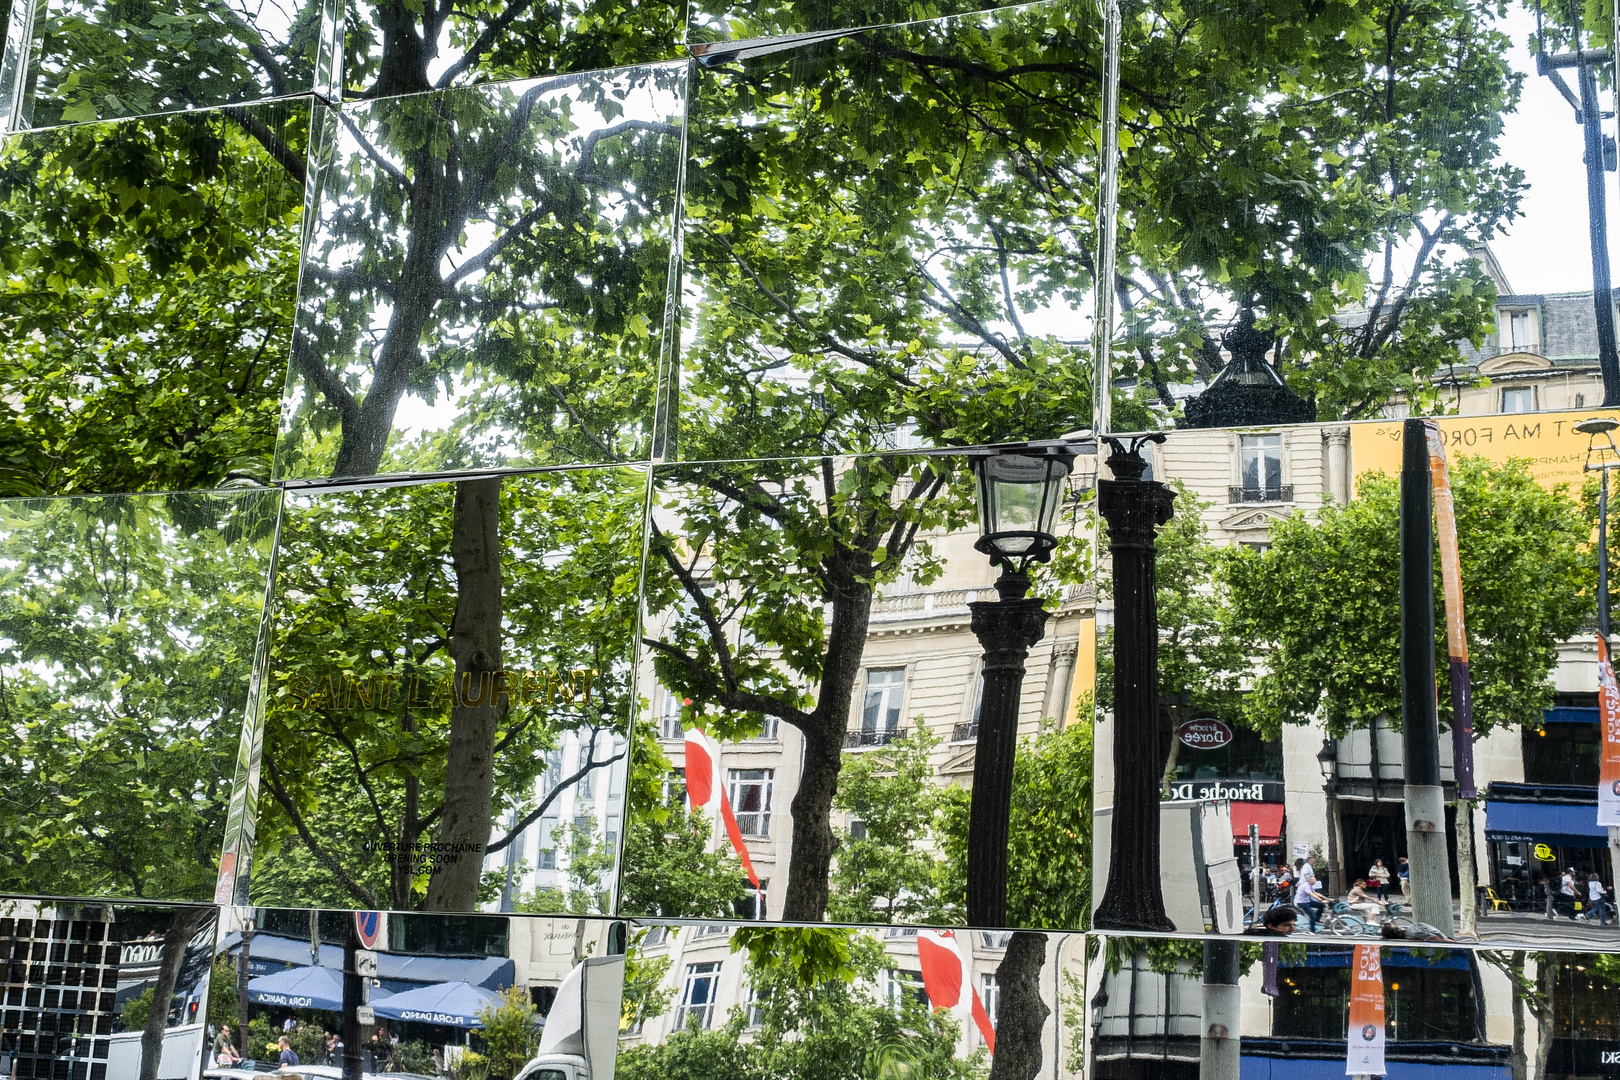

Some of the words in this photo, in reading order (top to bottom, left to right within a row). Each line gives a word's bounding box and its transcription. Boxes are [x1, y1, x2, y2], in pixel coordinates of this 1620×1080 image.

[286, 673, 400, 711] SAINT
[407, 669, 599, 709] LAURENT
[363, 842, 421, 852] OUVERTURE
[423, 843, 482, 853] PROCHAINE
[384, 853, 427, 863] OPENING
[429, 854, 458, 864] SOON
[398, 865, 441, 875] YSL.COM
